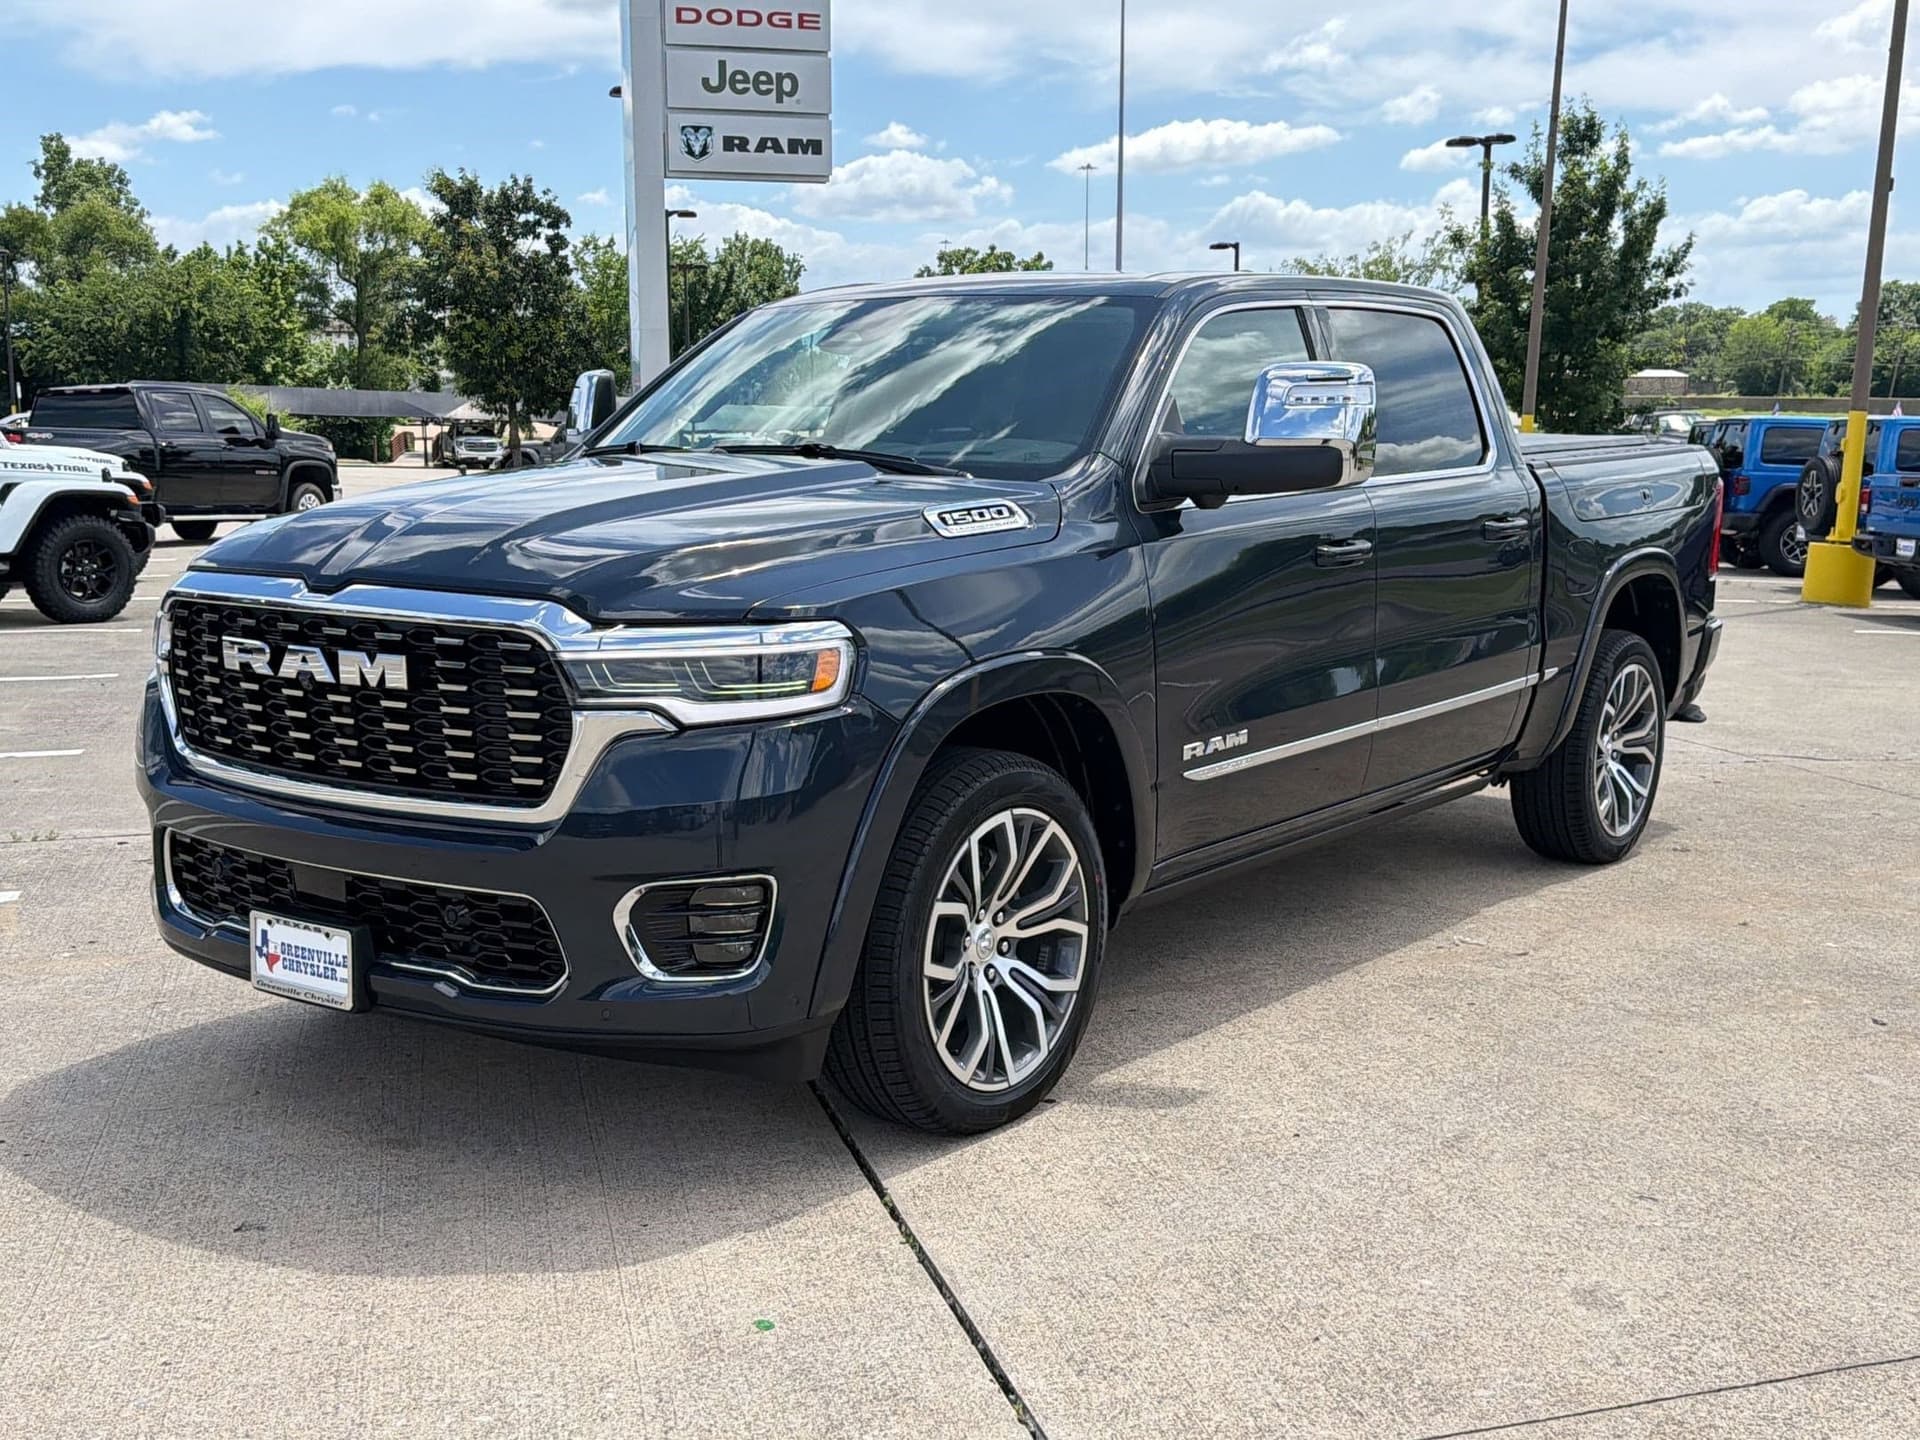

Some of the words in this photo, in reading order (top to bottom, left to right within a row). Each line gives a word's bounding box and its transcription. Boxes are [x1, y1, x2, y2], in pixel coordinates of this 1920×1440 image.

[675, 7, 821, 30] DODGE
[701, 59, 799, 104] Jeep
[722, 135, 823, 155] RAM
[3, 462, 45, 471] TEXAS
[54, 464, 92, 473] TRAIL
[941, 506, 1010, 526] 1500
[221, 635, 409, 690] RAM
[1183, 728, 1249, 761] RAM
[275, 919, 322, 933] TEXAS
[280, 941, 348, 968] GREENVILLE
[281, 957, 338, 982] CHRYSLER
[256, 979, 301, 997] Greenville
[303, 991, 345, 1006] Chrysler
